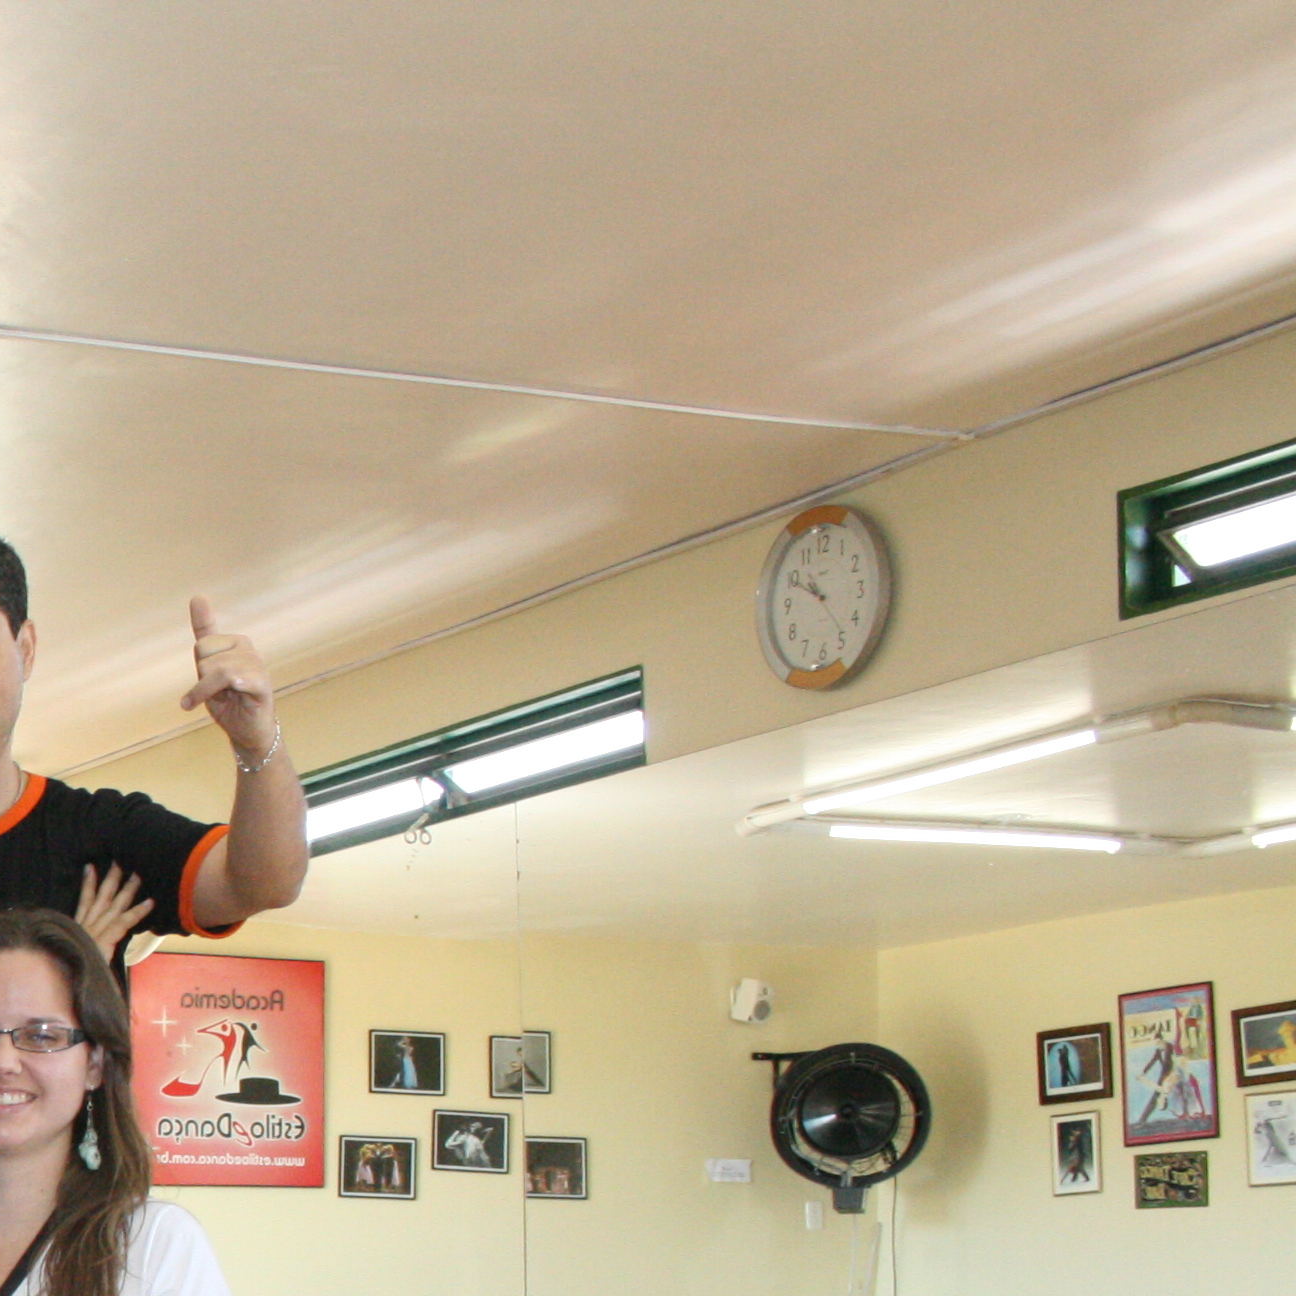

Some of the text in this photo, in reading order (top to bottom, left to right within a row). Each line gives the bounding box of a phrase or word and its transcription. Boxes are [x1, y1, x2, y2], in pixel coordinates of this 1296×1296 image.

[817, 534, 830, 554] 12
[800, 547, 811, 566] 11
[850, 554, 860, 573] 2
[856, 580, 865, 599] 3
[784, 597, 792, 616] 9
[850, 609, 860, 628] 4
[788, 623, 797, 641] 8
[837, 630, 846, 650] 5
[801, 638, 810, 658] 7
[818, 641, 827, 661] 6
